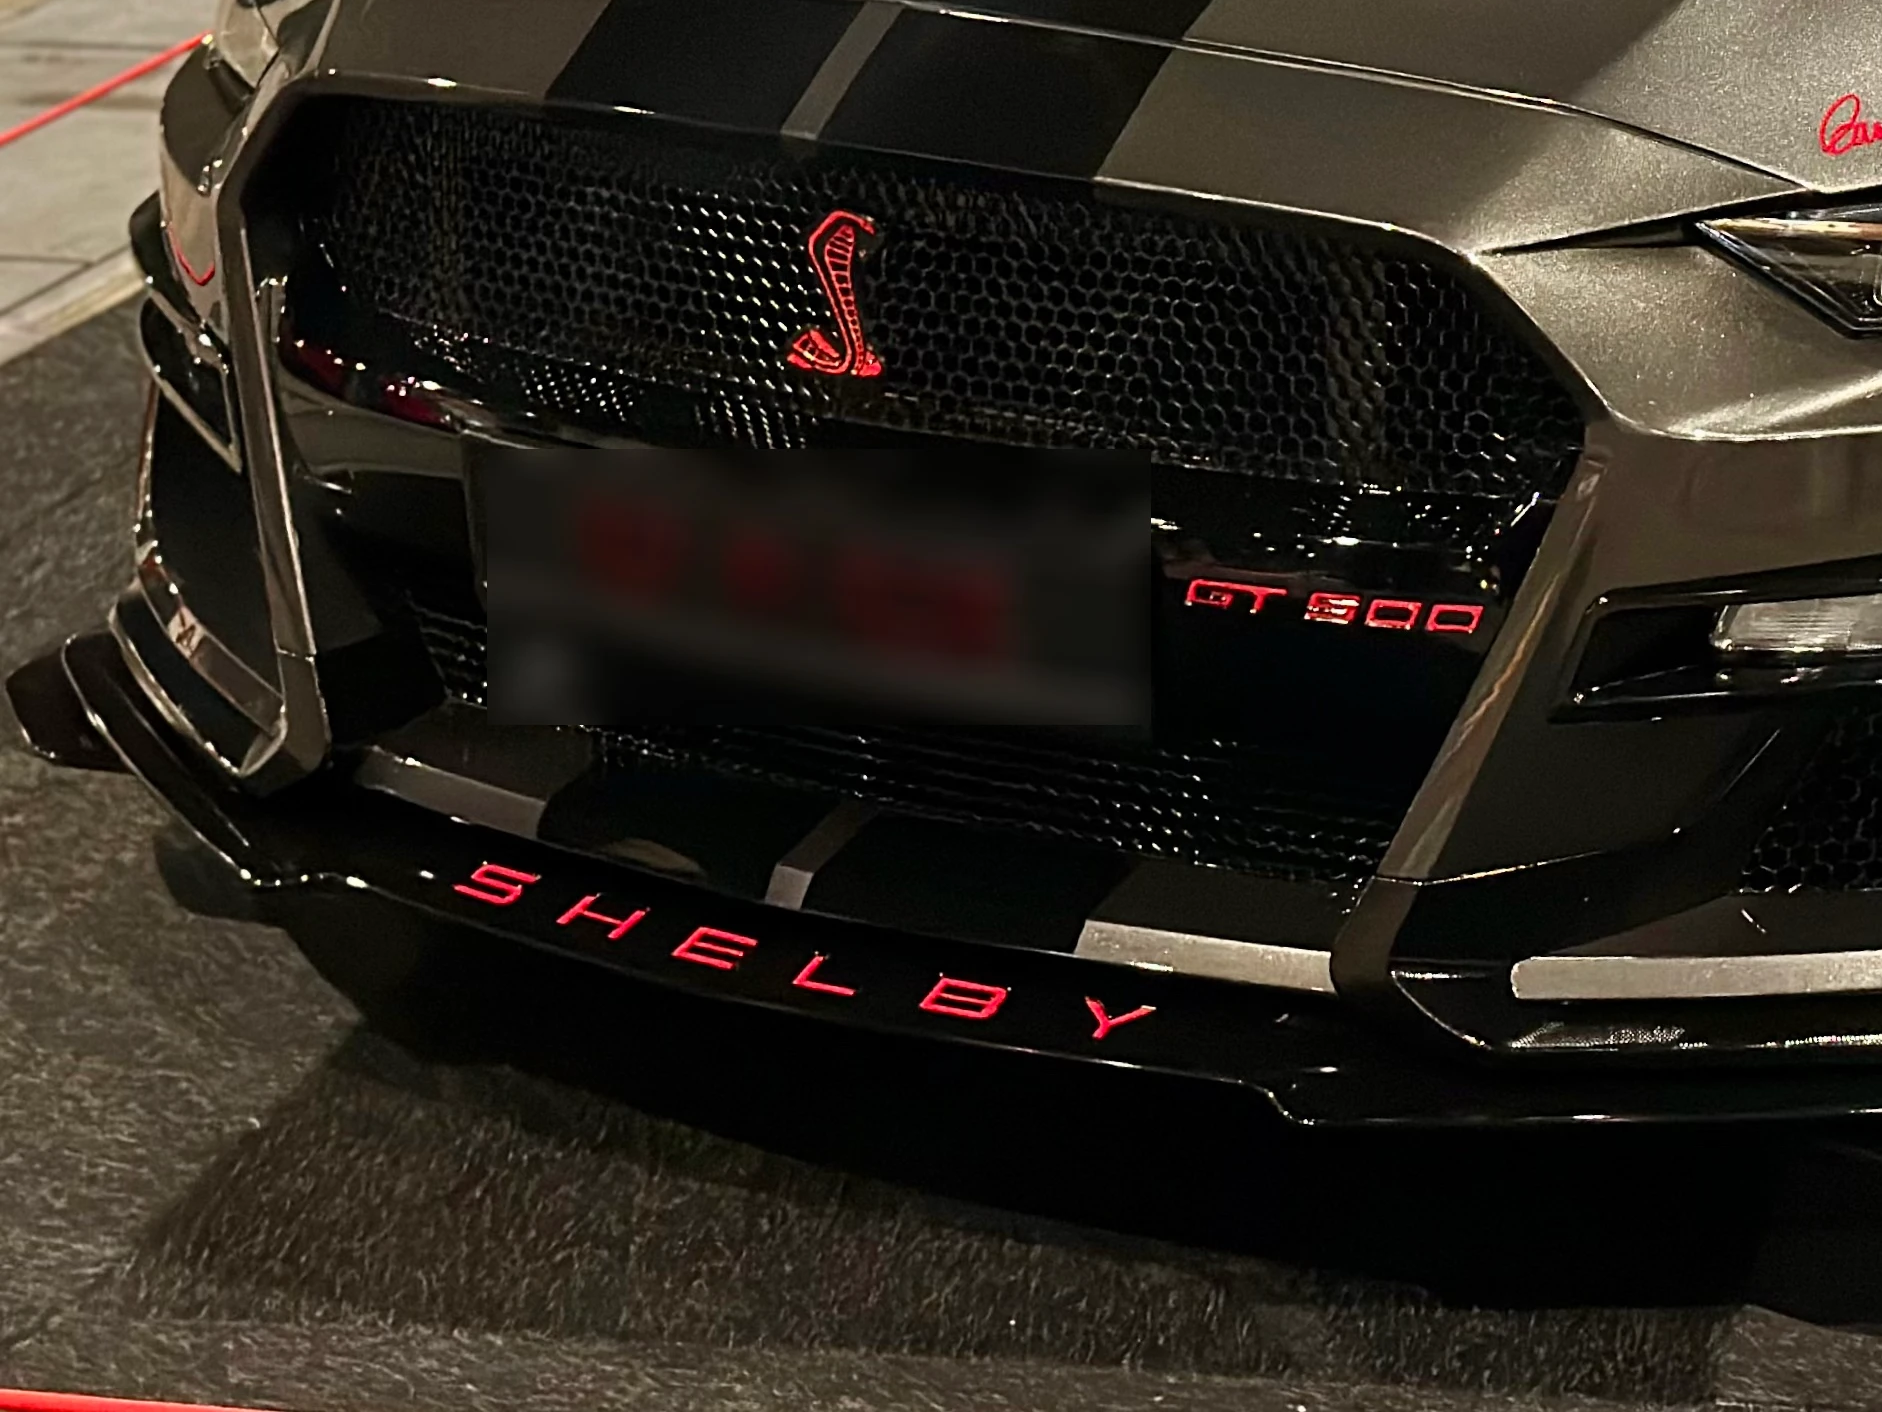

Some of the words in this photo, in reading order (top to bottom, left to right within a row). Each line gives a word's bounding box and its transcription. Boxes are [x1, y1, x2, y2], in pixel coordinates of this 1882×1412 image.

[1184, 578, 1289, 615] GT
[1303, 591, 1486, 635] 500
[452, 861, 1158, 1040] SHELBY
